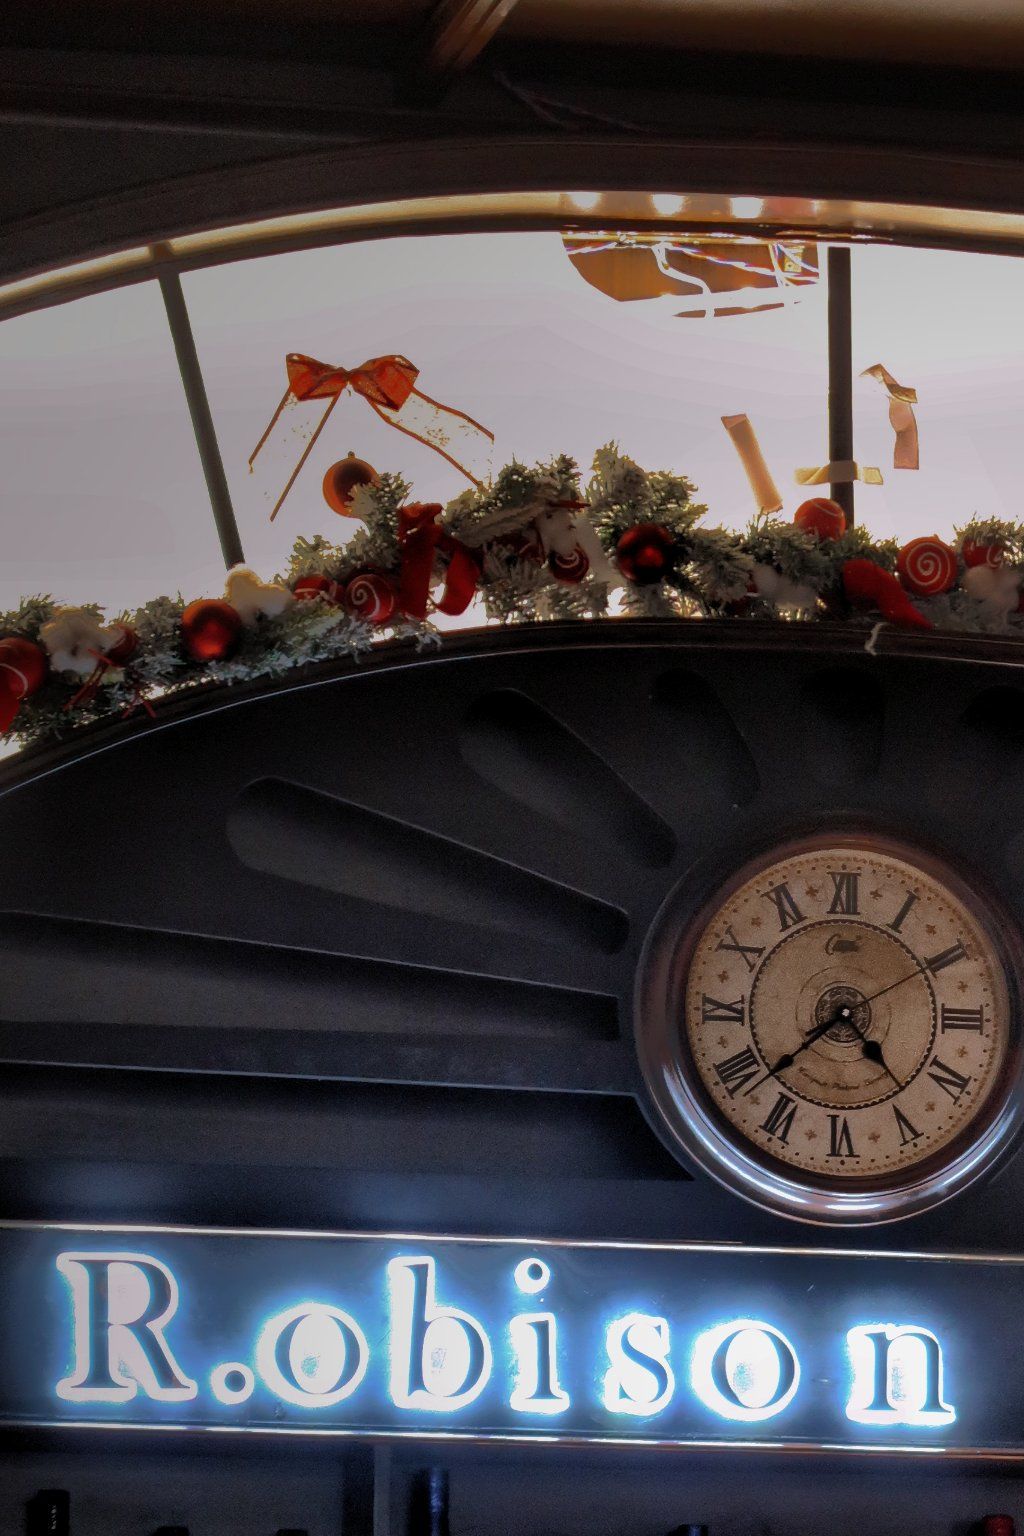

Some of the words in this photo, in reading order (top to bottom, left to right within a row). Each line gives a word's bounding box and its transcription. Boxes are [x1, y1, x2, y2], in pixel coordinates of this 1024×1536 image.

[761, 882, 807, 932] XI
[827, 871, 861, 915] XII
[717, 925, 766, 972] X
[924, 939, 968, 978] II
[701, 994, 746, 1026] IX
[941, 1003, 985, 1035] III
[759, 1091, 799, 1145] VII
[827, 1114, 860, 1158] VI
[892, 1104, 925, 1147] V
